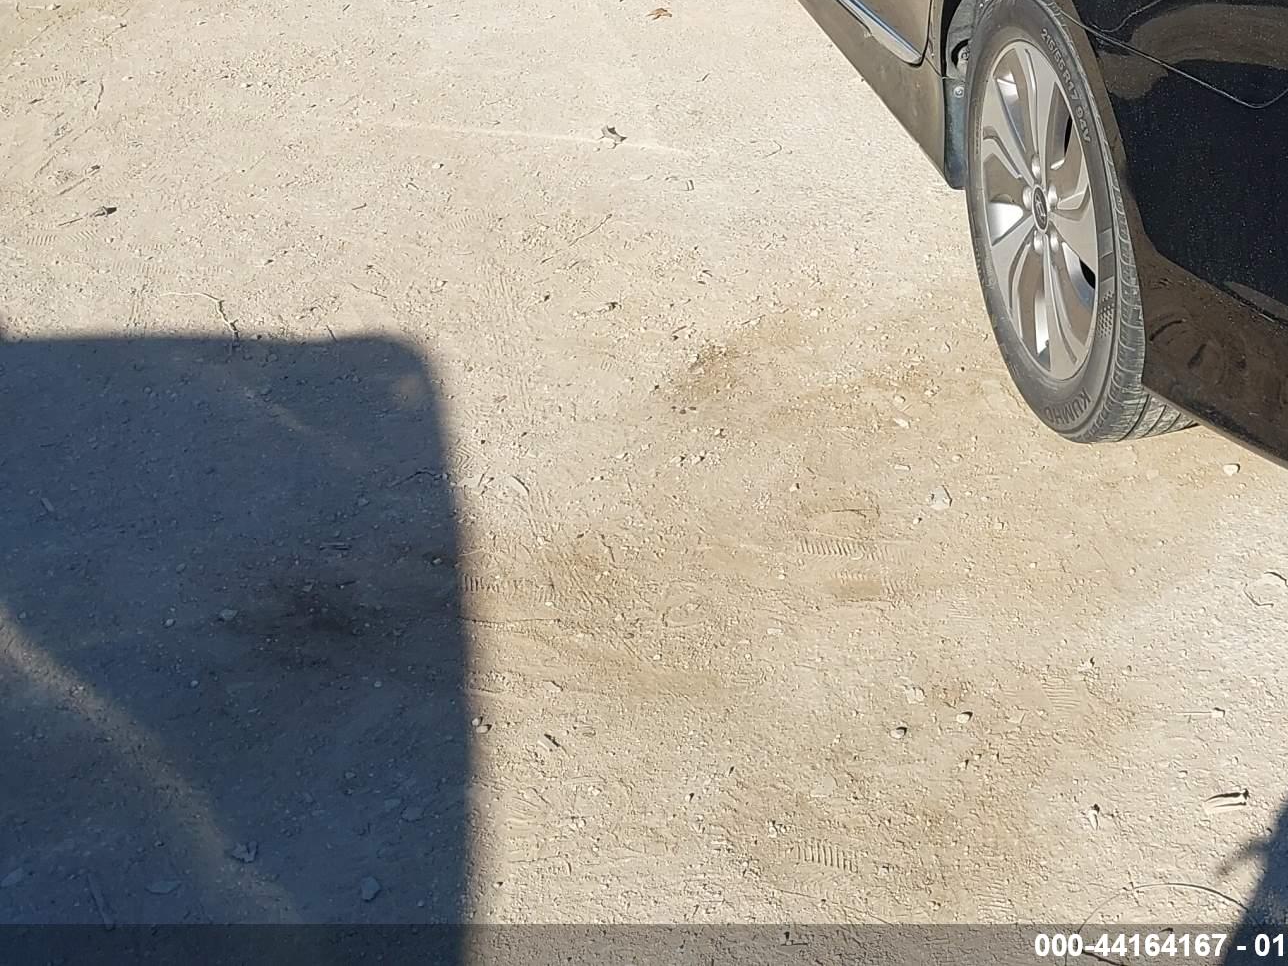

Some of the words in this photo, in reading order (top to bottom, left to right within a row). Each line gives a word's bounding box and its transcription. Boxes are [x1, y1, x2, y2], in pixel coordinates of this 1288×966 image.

[1040, 28, 1067, 70] 215/55
[1075, 105, 1091, 143] 94V
[1043, 386, 1092, 425] KUMHO
